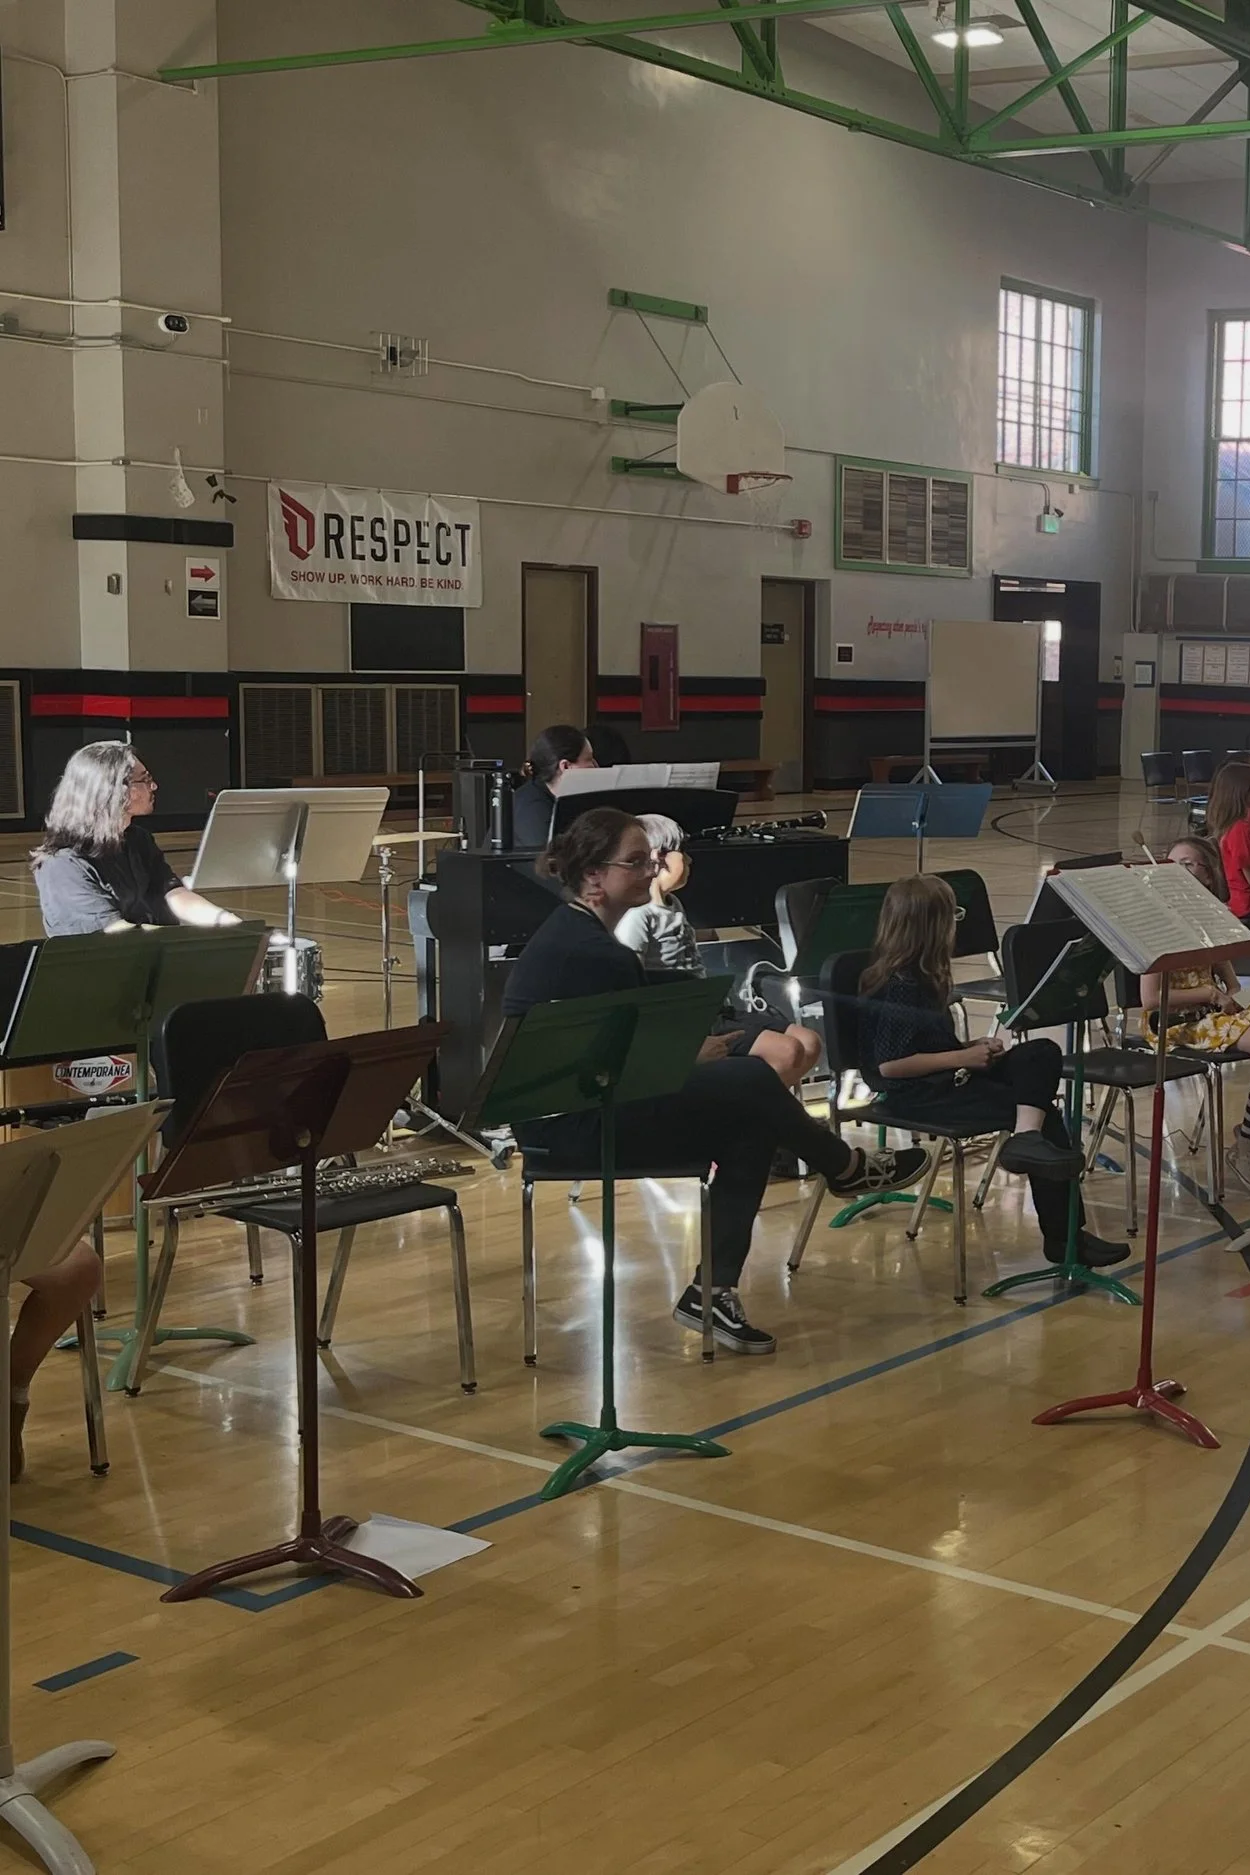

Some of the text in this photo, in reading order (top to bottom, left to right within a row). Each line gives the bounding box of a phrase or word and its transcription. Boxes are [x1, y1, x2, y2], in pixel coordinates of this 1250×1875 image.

[324, 513, 470, 567] RESPECT
[290, 570, 464, 590] SHOW UP. WORK HARD. BE KIND.
